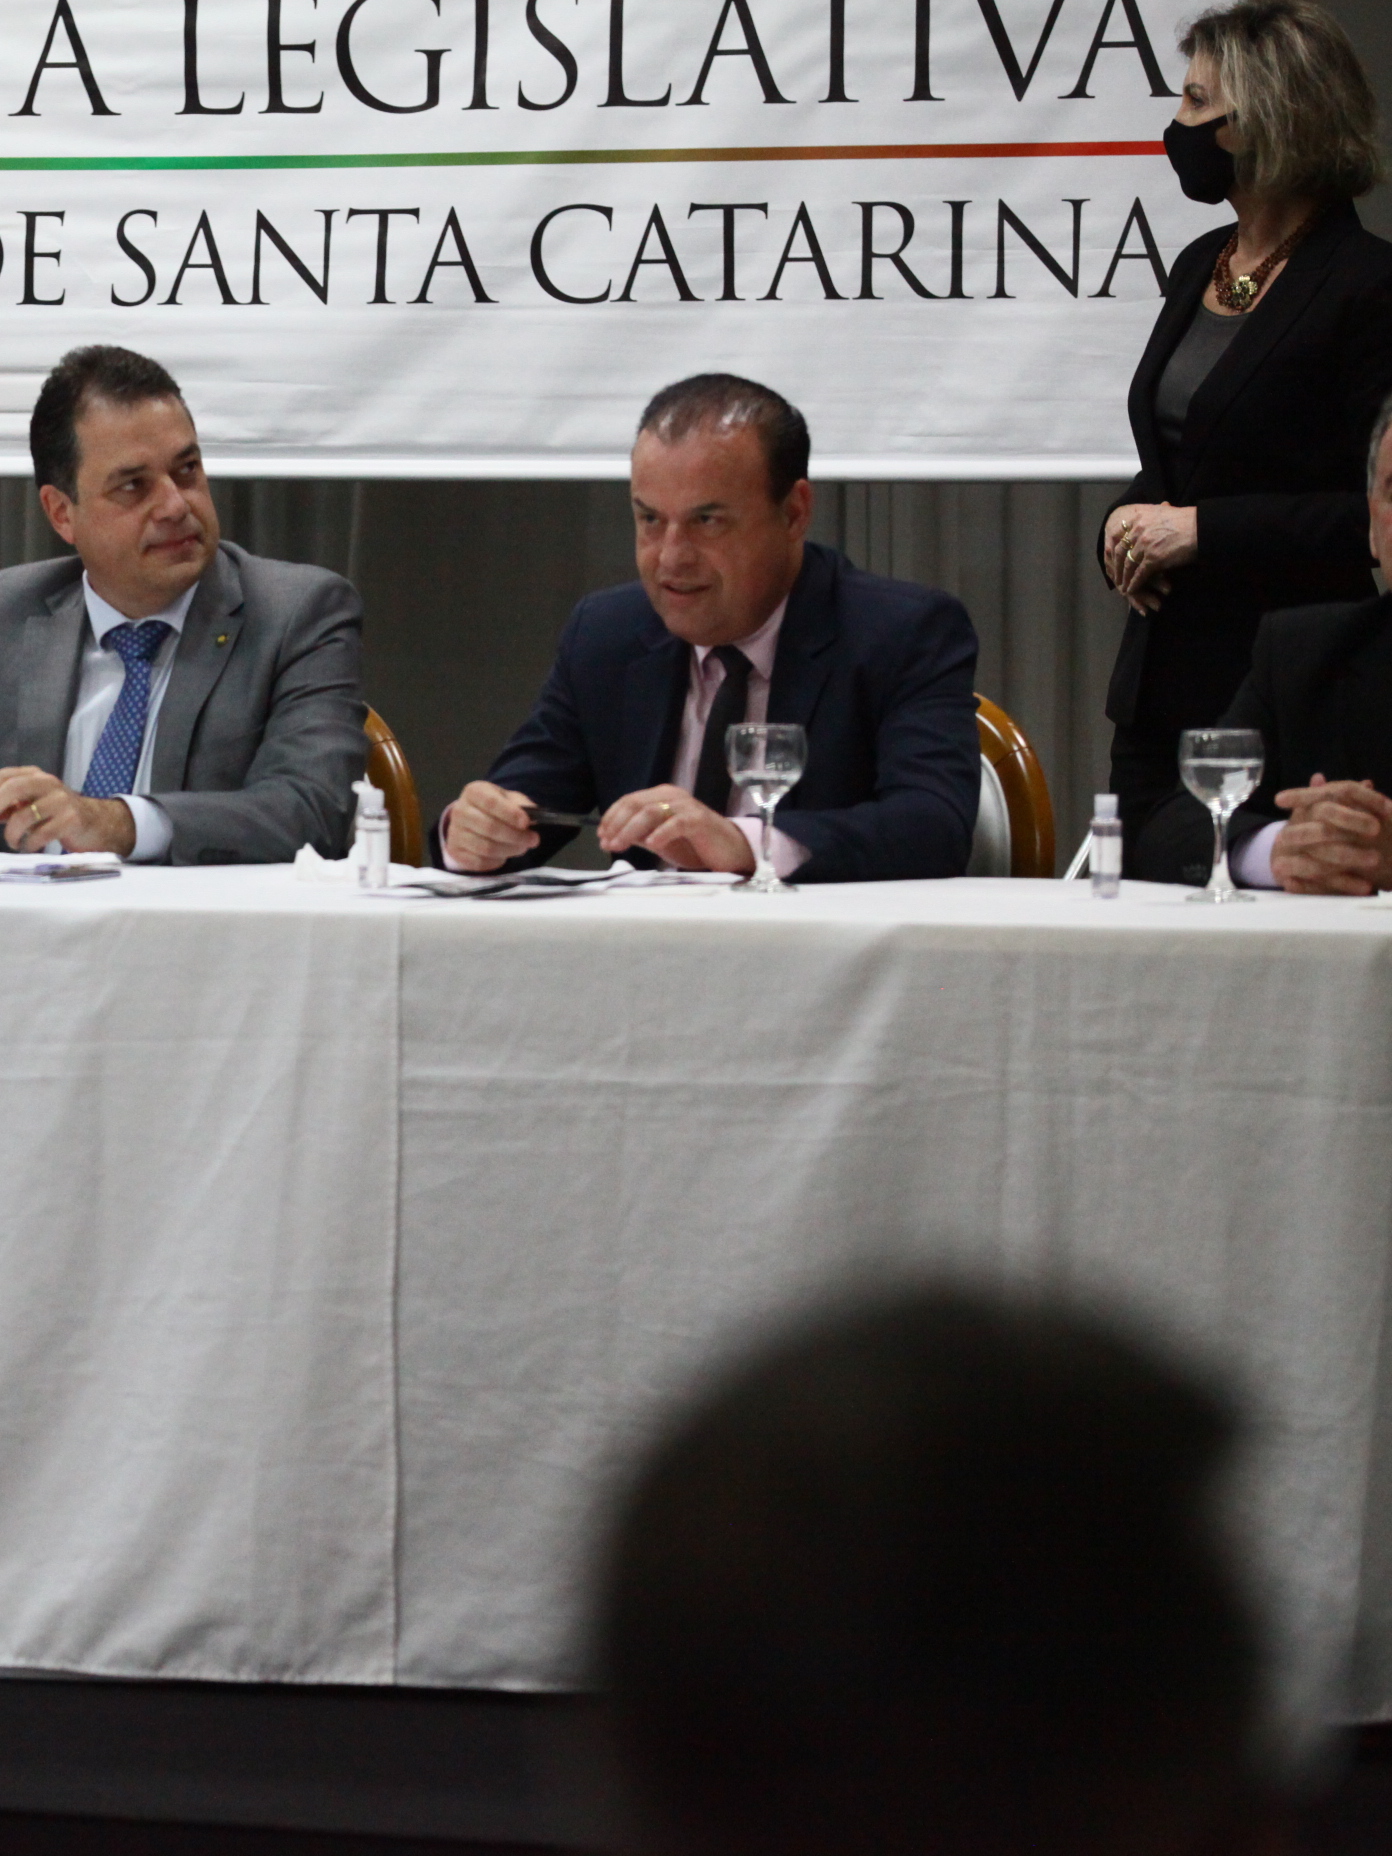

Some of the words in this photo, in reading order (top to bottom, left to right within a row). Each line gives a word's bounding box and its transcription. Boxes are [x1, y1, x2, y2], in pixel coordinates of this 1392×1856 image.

[174, 0, 1183, 115] LEGISLATIVA
[110, 206, 499, 307] SANTA
[529, 196, 1170, 305] CATARINA
